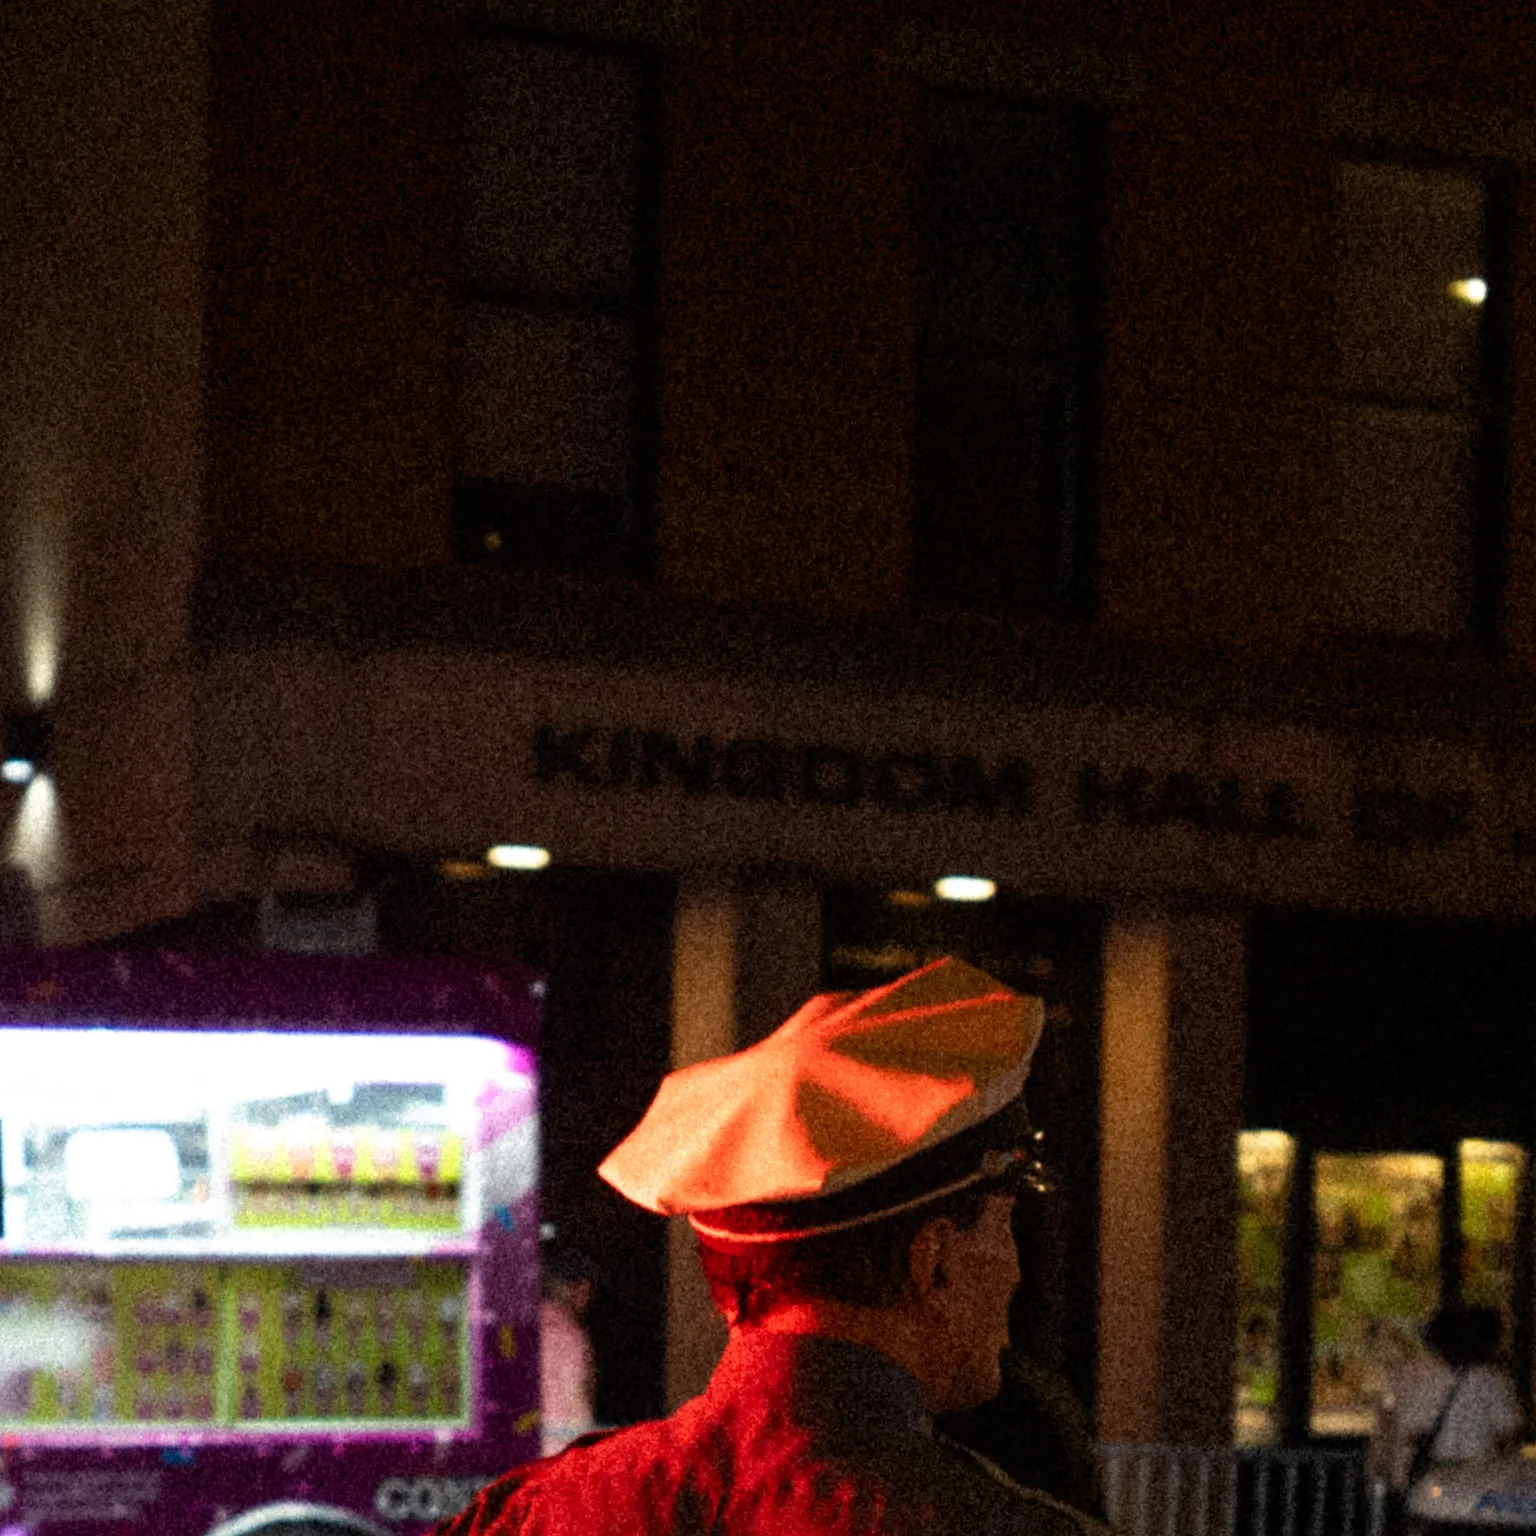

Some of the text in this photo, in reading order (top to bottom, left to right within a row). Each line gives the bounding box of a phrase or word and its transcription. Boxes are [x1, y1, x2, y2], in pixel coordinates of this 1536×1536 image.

[530, 724, 1031, 820] KINGDOM
[1075, 760, 1314, 840] HALL
[374, 1477, 494, 1522] CON
